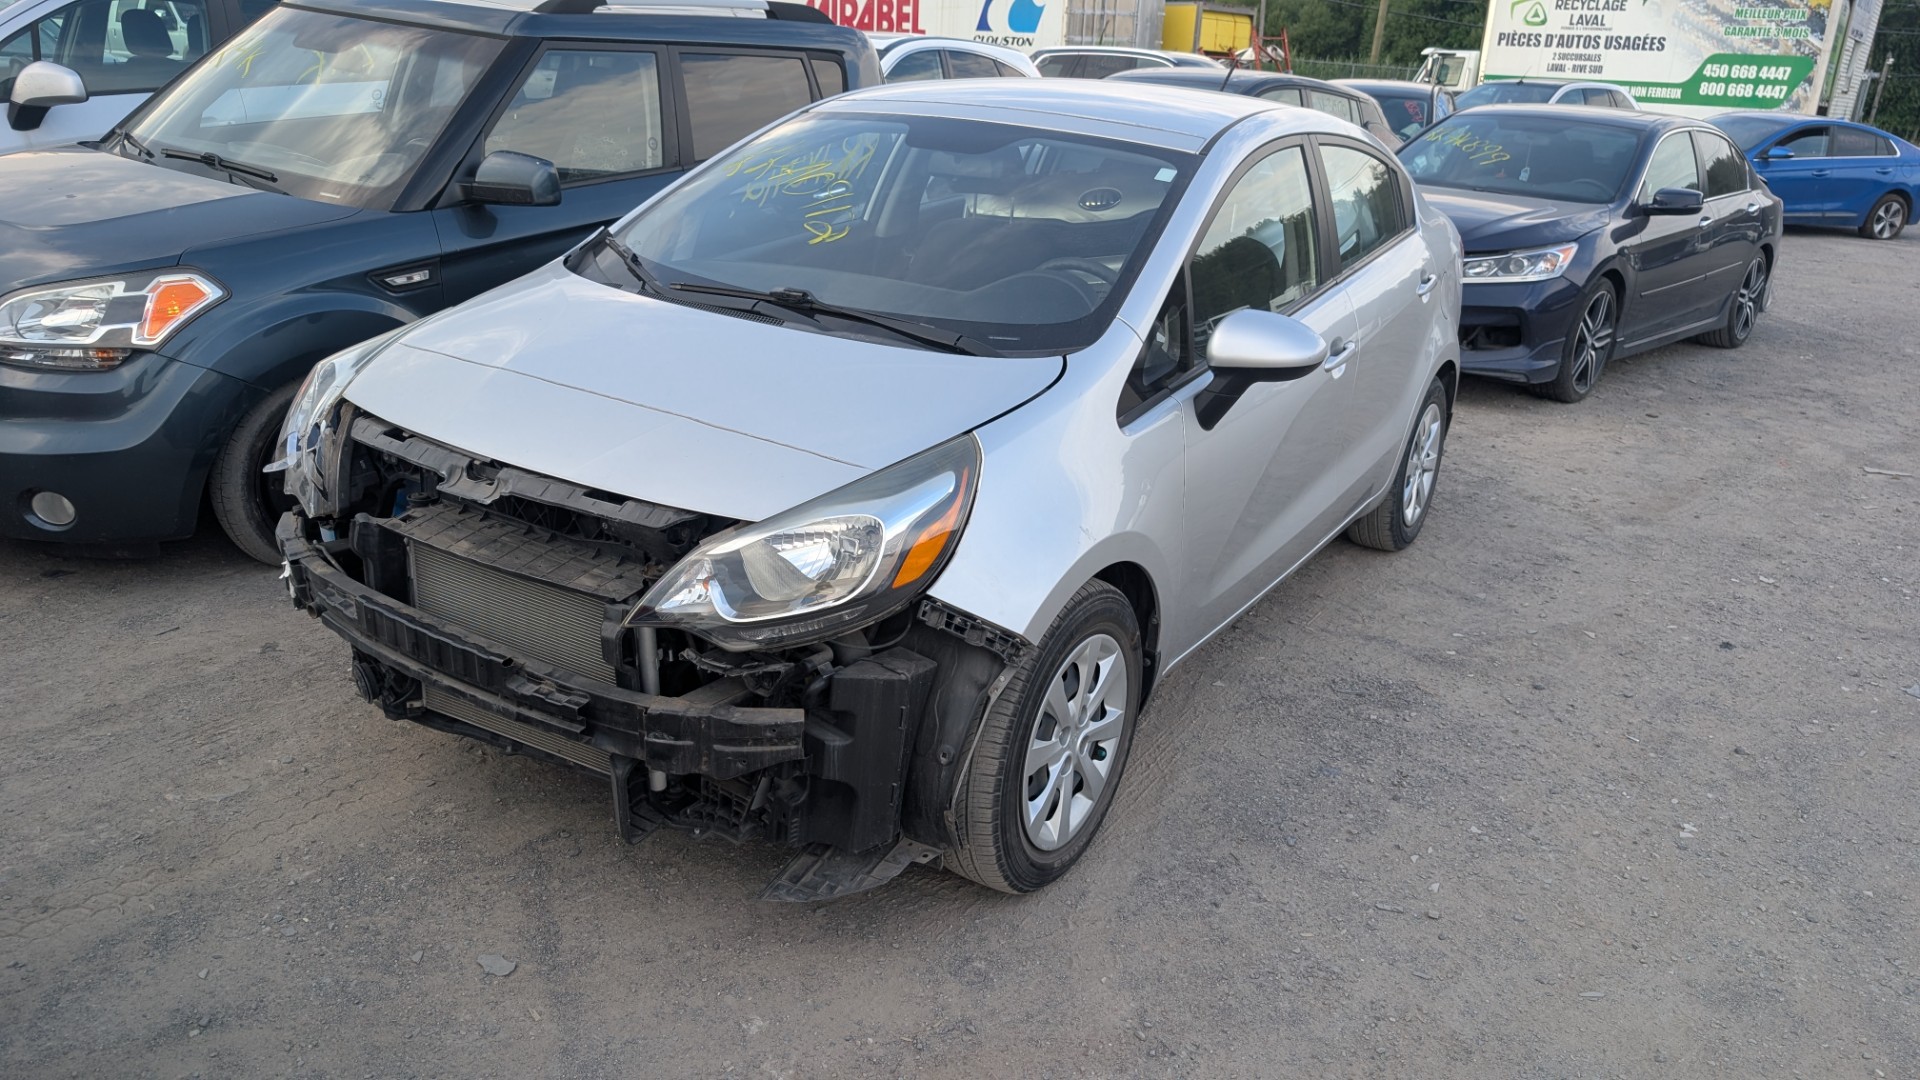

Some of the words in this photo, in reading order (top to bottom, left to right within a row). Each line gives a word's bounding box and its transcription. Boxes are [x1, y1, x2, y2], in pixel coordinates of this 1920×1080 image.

[1555, 0, 1628, 12] RECYCLAGE
[1569, 14, 1606, 27] LAVAL
[1734, 8, 1781, 20] MEILLEUR
[1783, 9, 1808, 21] PRIX
[1723, 26, 1772, 38] GARANTIE
[1773, 27, 1781, 38] 3
[1782, 27, 1810, 39] MOIS
[973, 35, 1035, 47] CLOUSTON
[1497, 31, 1542, 48] PIÈCES
[1544, 33, 1601, 50] D'AUTOS
[1604, 33, 1667, 52] USAGÉES
[1552, 53, 1557, 61] 2
[1558, 53, 1602, 62] SUCCURSALES
[1546, 63, 1567, 73] LAVAL
[1571, 64, 1587, 74] RIVE
[1588, 64, 1604, 75] SUD
[1703, 63, 1729, 79] 450
[1731, 65, 1758, 80] 668
[1759, 66, 1792, 81] 4447
[1630, 85, 1648, 98] NON
[1647, 87, 1683, 100] FERREUX
[1699, 82, 1726, 96] 800
[1728, 83, 1755, 98] 668
[1756, 85, 1788, 100] 4447
